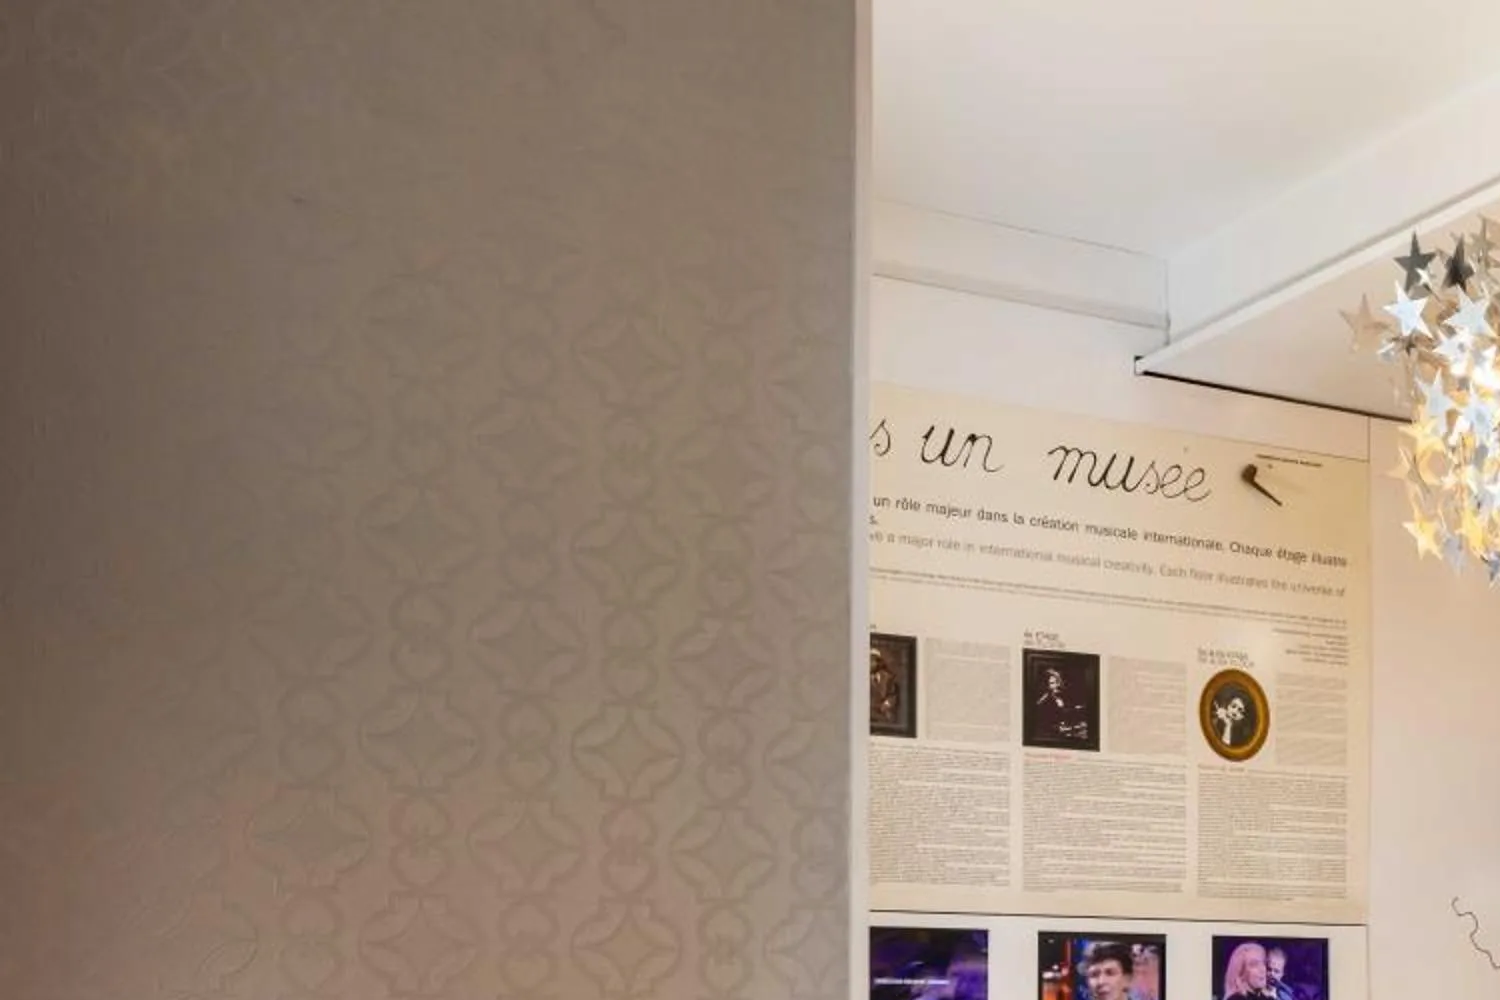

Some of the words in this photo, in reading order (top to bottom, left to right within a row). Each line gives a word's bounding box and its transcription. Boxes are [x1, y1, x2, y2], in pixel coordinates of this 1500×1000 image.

[921, 425, 1004, 473] un
[873, 497, 890, 507] un
[895, 498, 920, 511] rôle
[926, 502, 972, 519] majeur
[978, 508, 1008, 522] dans
[1013, 512, 1025, 525] la
[1029, 515, 1079, 532] création
[1085, 524, 1138, 541] musicale
[1229, 541, 1273, 558] Chaque
